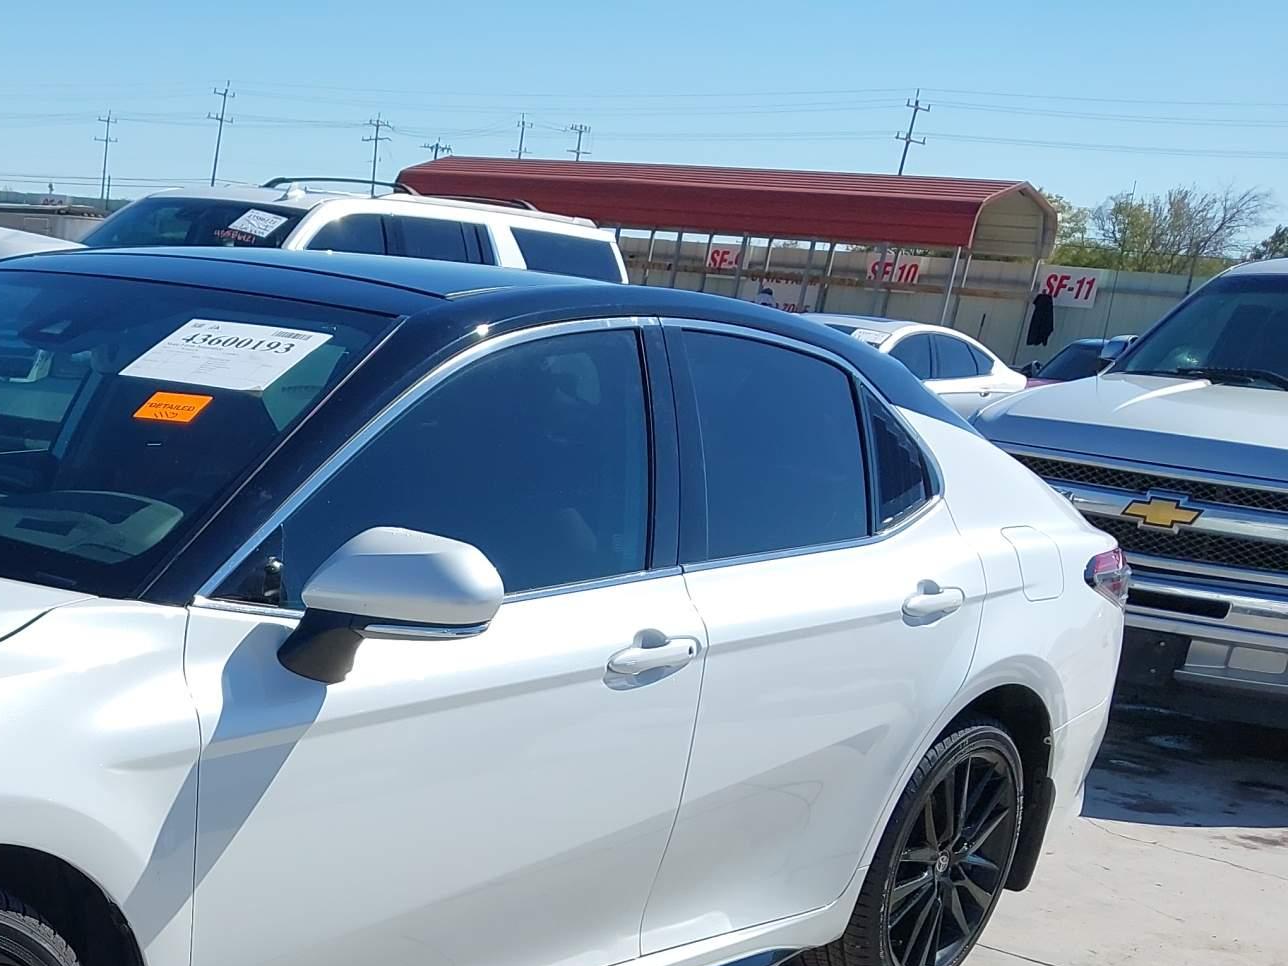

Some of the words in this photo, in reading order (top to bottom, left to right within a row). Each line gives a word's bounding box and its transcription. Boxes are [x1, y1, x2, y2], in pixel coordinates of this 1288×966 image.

[711, 249, 740, 268] SF-
[1042, 273, 1096, 300] SF-11
[181, 332, 296, 354] 43600193
